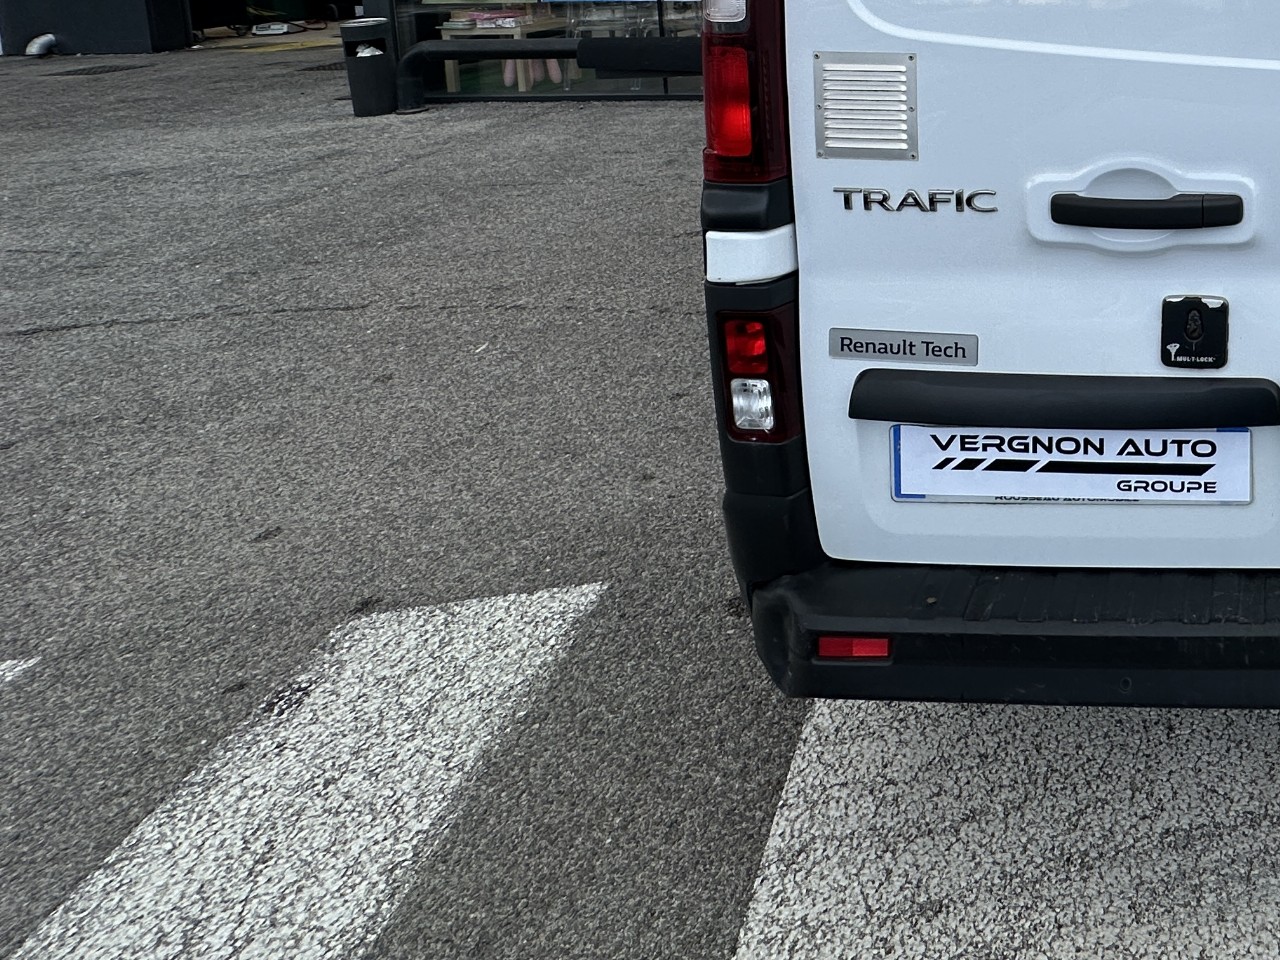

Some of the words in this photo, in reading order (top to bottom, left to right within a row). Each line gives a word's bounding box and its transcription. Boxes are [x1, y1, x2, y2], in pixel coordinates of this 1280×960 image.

[833, 187, 998, 213] TRAFIC
[839, 336, 916, 356] Renault
[921, 340, 967, 359] Tech
[929, 434, 1105, 456] VERGNON
[1116, 438, 1217, 458] AUTO
[1116, 479, 1217, 494] GROUPE
